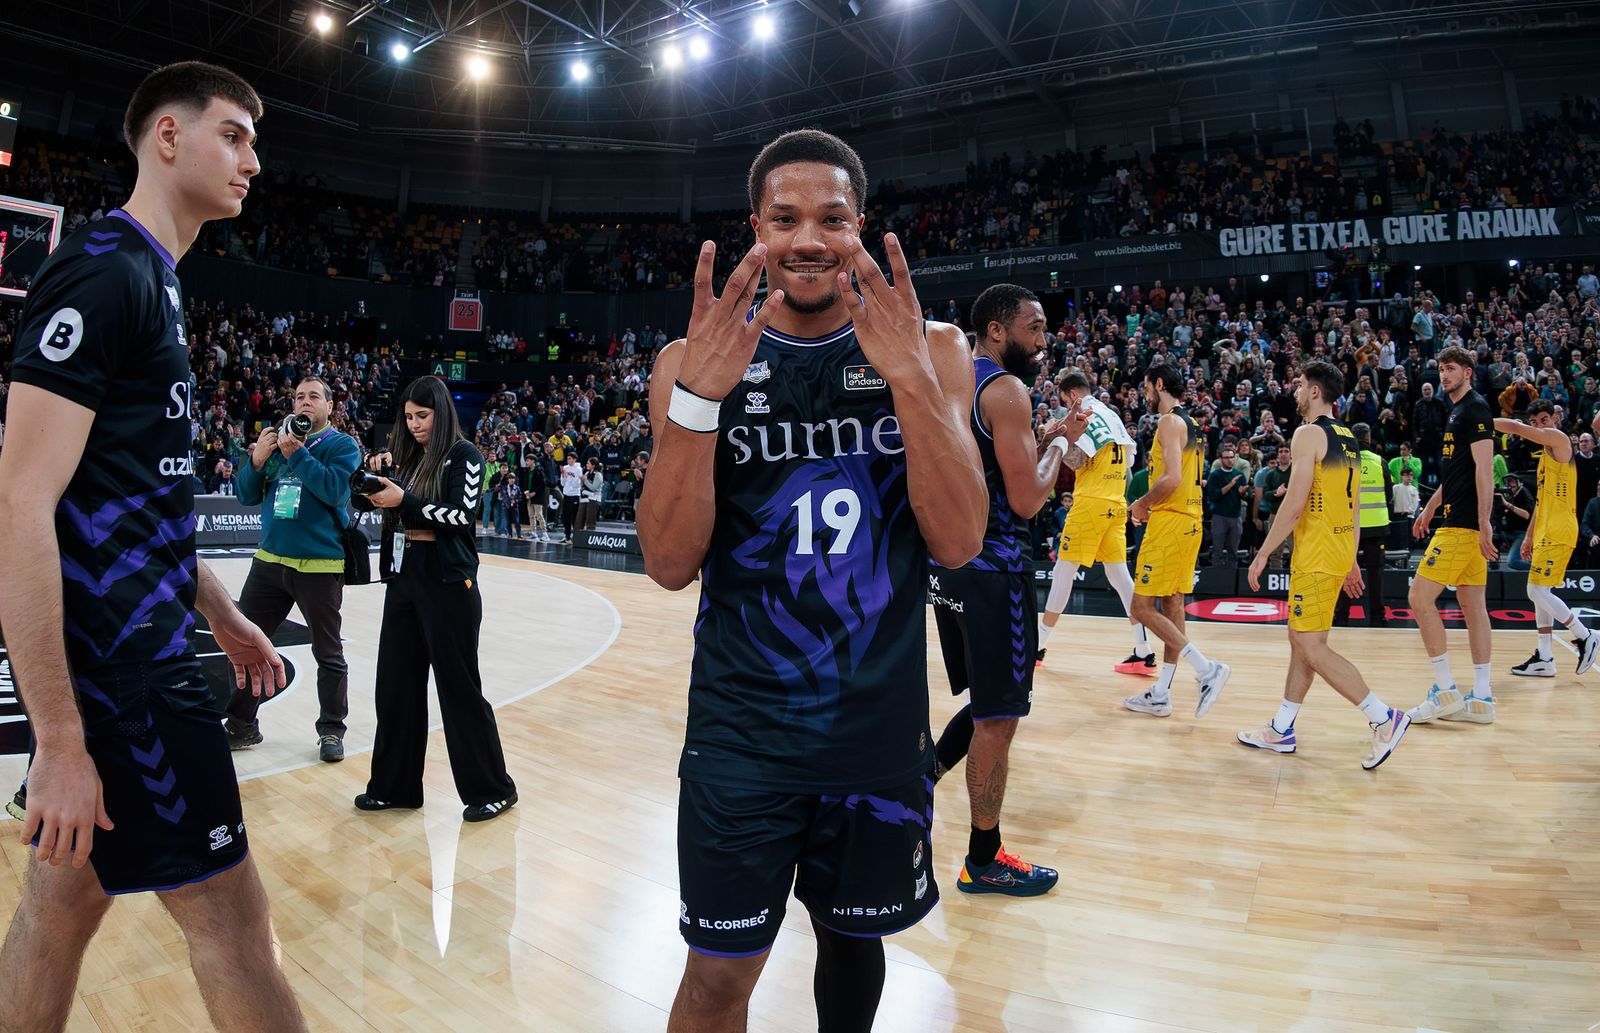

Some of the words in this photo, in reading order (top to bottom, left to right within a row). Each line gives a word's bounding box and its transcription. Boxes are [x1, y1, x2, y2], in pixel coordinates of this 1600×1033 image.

[1219, 223, 1287, 257] GURE
[1382, 213, 1451, 246] GURE
[1456, 207, 1561, 241] ARAUAK
[1094, 241, 1183, 257] www.bilbaobasket.biz
[1017, 254, 1047, 265] BASKET
[1047, 251, 1079, 262] OFICIAL
[458, 303, 475, 317] 25
[46, 321, 74, 351] B
[433, 363, 444, 375] A
[848, 371, 865, 380] liga
[848, 377, 883, 387] endesa
[746, 404, 770, 413] hummel
[727, 414, 905, 465] surne
[790, 488, 862, 555] 19
[832, 903, 903, 917] NISSAN
[698, 917, 714, 930] EL
[714, 913, 767, 931] CORREO
